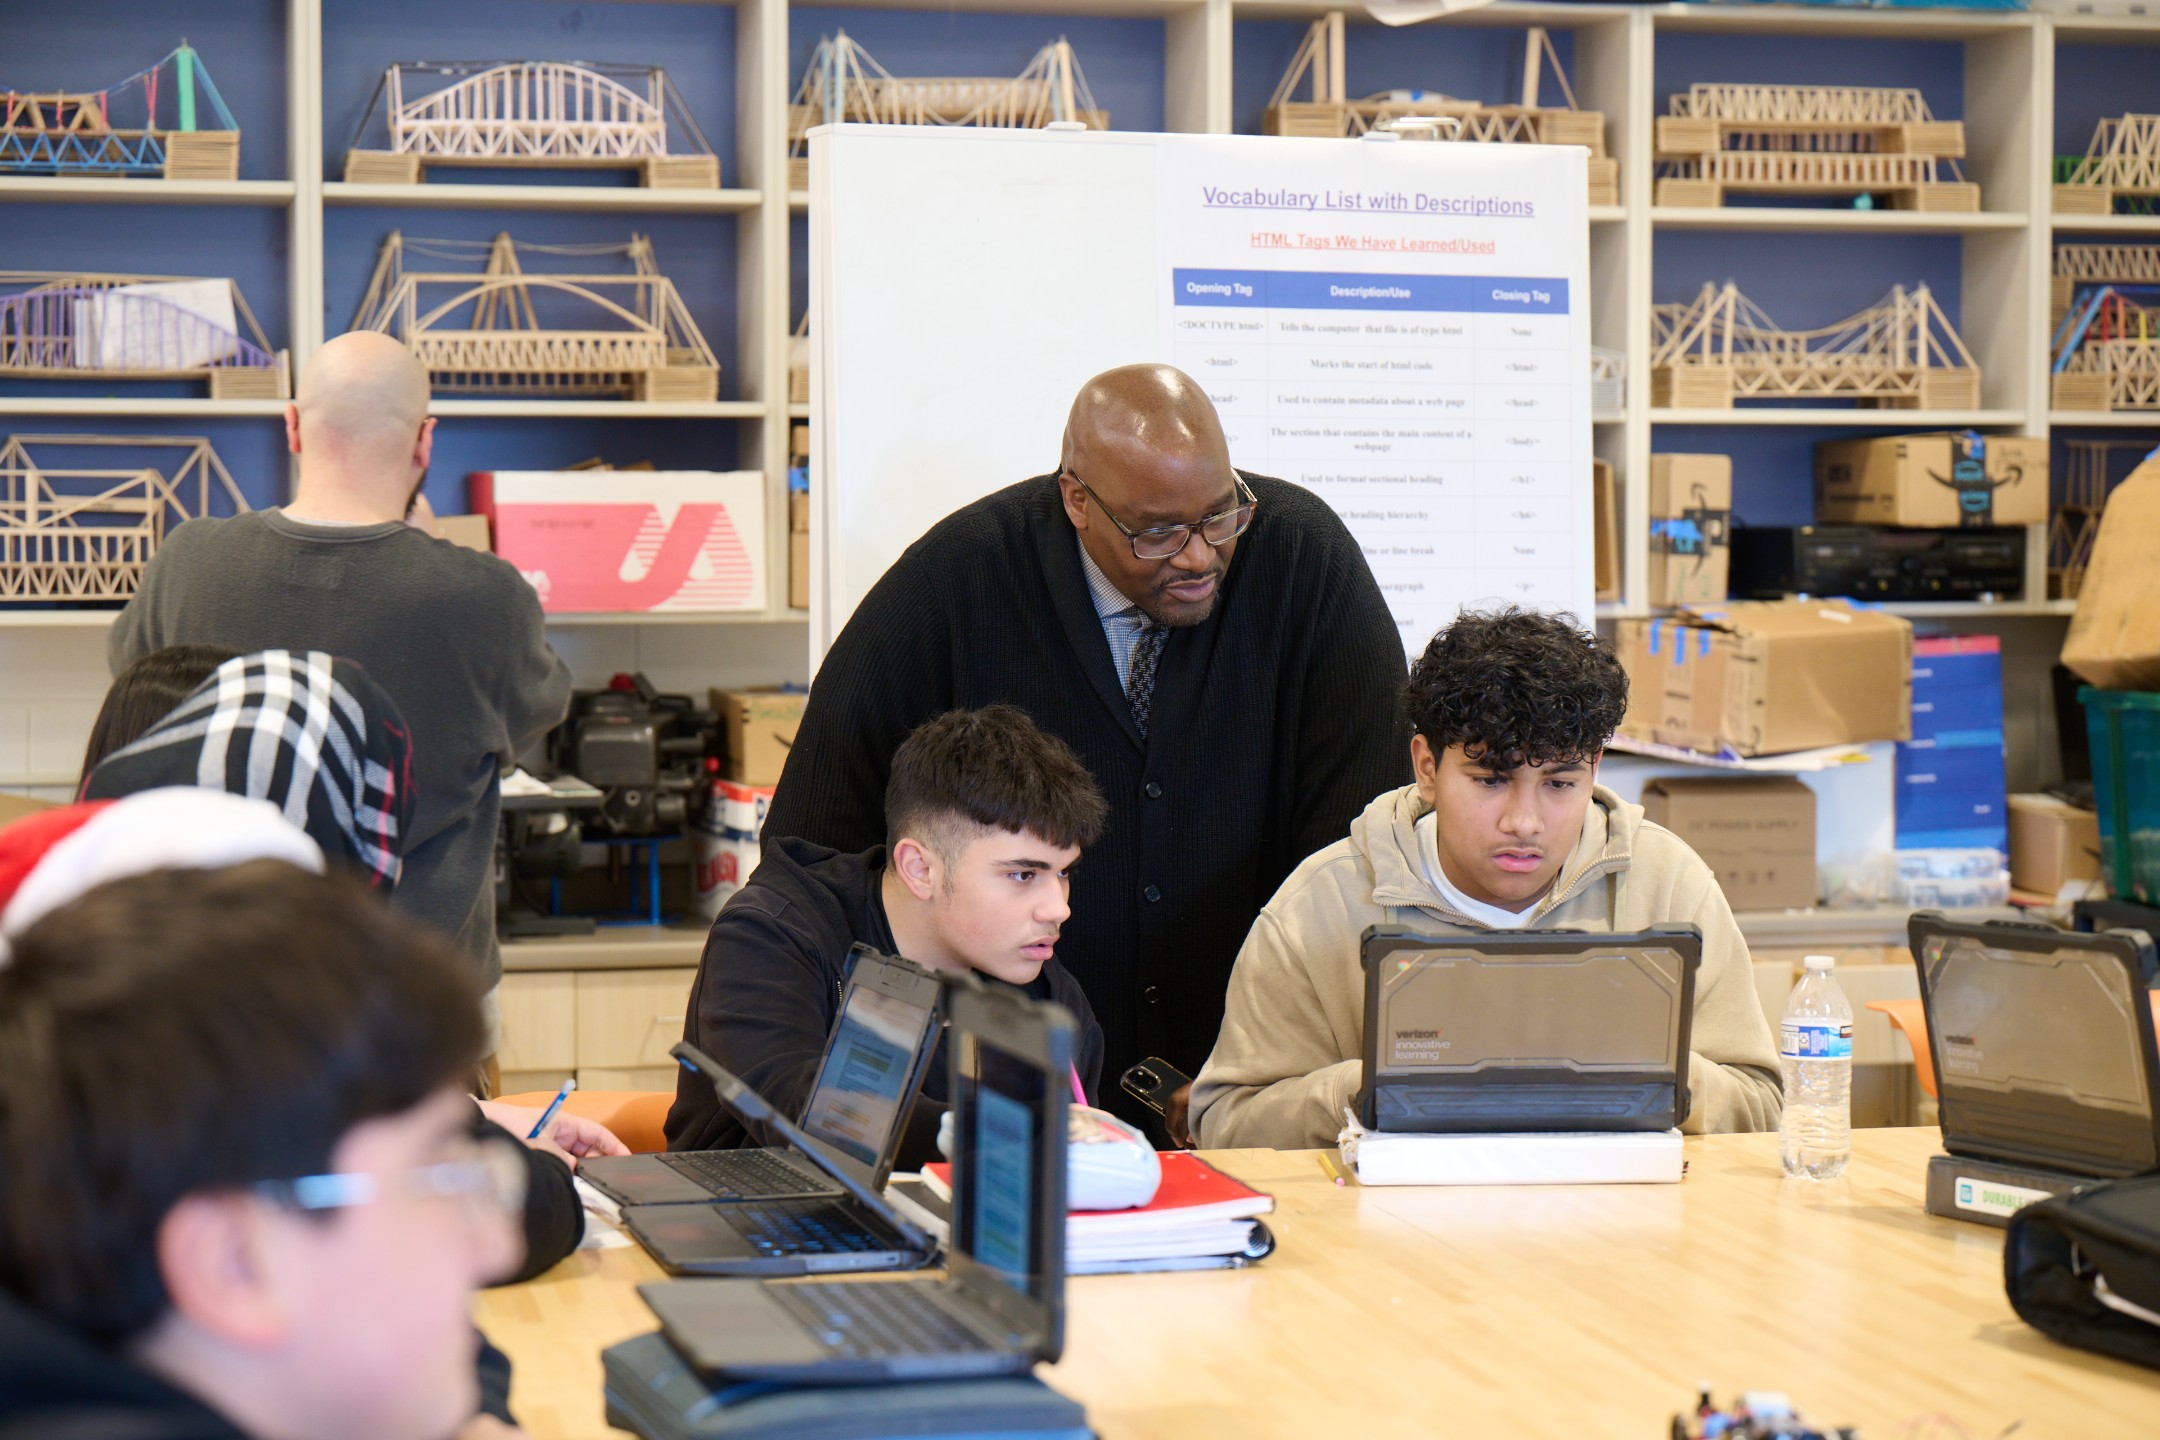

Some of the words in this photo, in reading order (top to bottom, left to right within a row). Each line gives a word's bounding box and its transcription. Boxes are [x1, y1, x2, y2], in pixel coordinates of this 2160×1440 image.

[1203, 186, 1318, 211] Vocabulary
[1326, 190, 1362, 208] List
[1368, 192, 1408, 210] with
[1415, 193, 1534, 216] Descriptions
[1251, 232, 1292, 246] HTML
[1297, 234, 1330, 249] Tags
[1336, 235, 1357, 248] We
[1362, 236, 1397, 249] Have
[1401, 237, 1495, 252] Learned/Used
[1186, 281, 1232, 297] Opening
[1233, 283, 1253, 297] Tag
[1330, 285, 1412, 299] Description/Use
[1492, 289, 1531, 304] Closing
[1532, 290, 1551, 304] Tag
[1280, 322, 1300, 332] Tells
[1302, 323, 1315, 332] the
[1317, 324, 1360, 334] computer
[1365, 325, 1382, 334] that
[1384, 325, 1399, 334] file
[1400, 326, 1408, 334] is
[1410, 325, 1420, 334] of
[1421, 327, 1440, 336] type
[1442, 326, 1463, 335] html
[1511, 327, 1533, 336] None
[1310, 359, 1339, 369] Marks
[1341, 360, 1355, 369] the
[1357, 361, 1377, 369] start
[1380, 361, 1389, 369] of
[1391, 361, 1412, 370] html
[1413, 362, 1433, 370] code
[1278, 395, 1300, 404] Used
[1302, 395, 1310, 404] to
[1312, 395, 1346, 405] contain
[1348, 396, 1389, 406] metadata
[1391, 397, 1416, 406] about
[1425, 397, 1443, 406] web
[1445, 399, 1465, 408] page
[1271, 428, 1288, 437] The
[1290, 428, 1321, 437] section
[1323, 429, 1341, 438] that
[1343, 428, 1380, 438] contains
[1382, 429, 1396, 438] the
[1398, 429, 1420, 438] main
[1422, 430, 1454, 438] content
[1456, 429, 1466, 438] of
[1354, 443, 1392, 453] webpage
[1301, 474, 1323, 484] Used
[1325, 475, 1334, 484] to
[1336, 474, 1367, 484] format
[1369, 475, 1407, 484] sectional
[1409, 475, 1443, 485] heading
[1349, 511, 1384, 521] heading
[1387, 511, 1429, 521] hierarchy
[1392, 547, 1409, 555] line
[1410, 547, 1435, 555] break
[1513, 546, 1535, 554] None
[1396, 1029, 1438, 1039] verizon
[1395, 1040, 1451, 1050] innovative
[1395, 1050, 1440, 1061] learning
